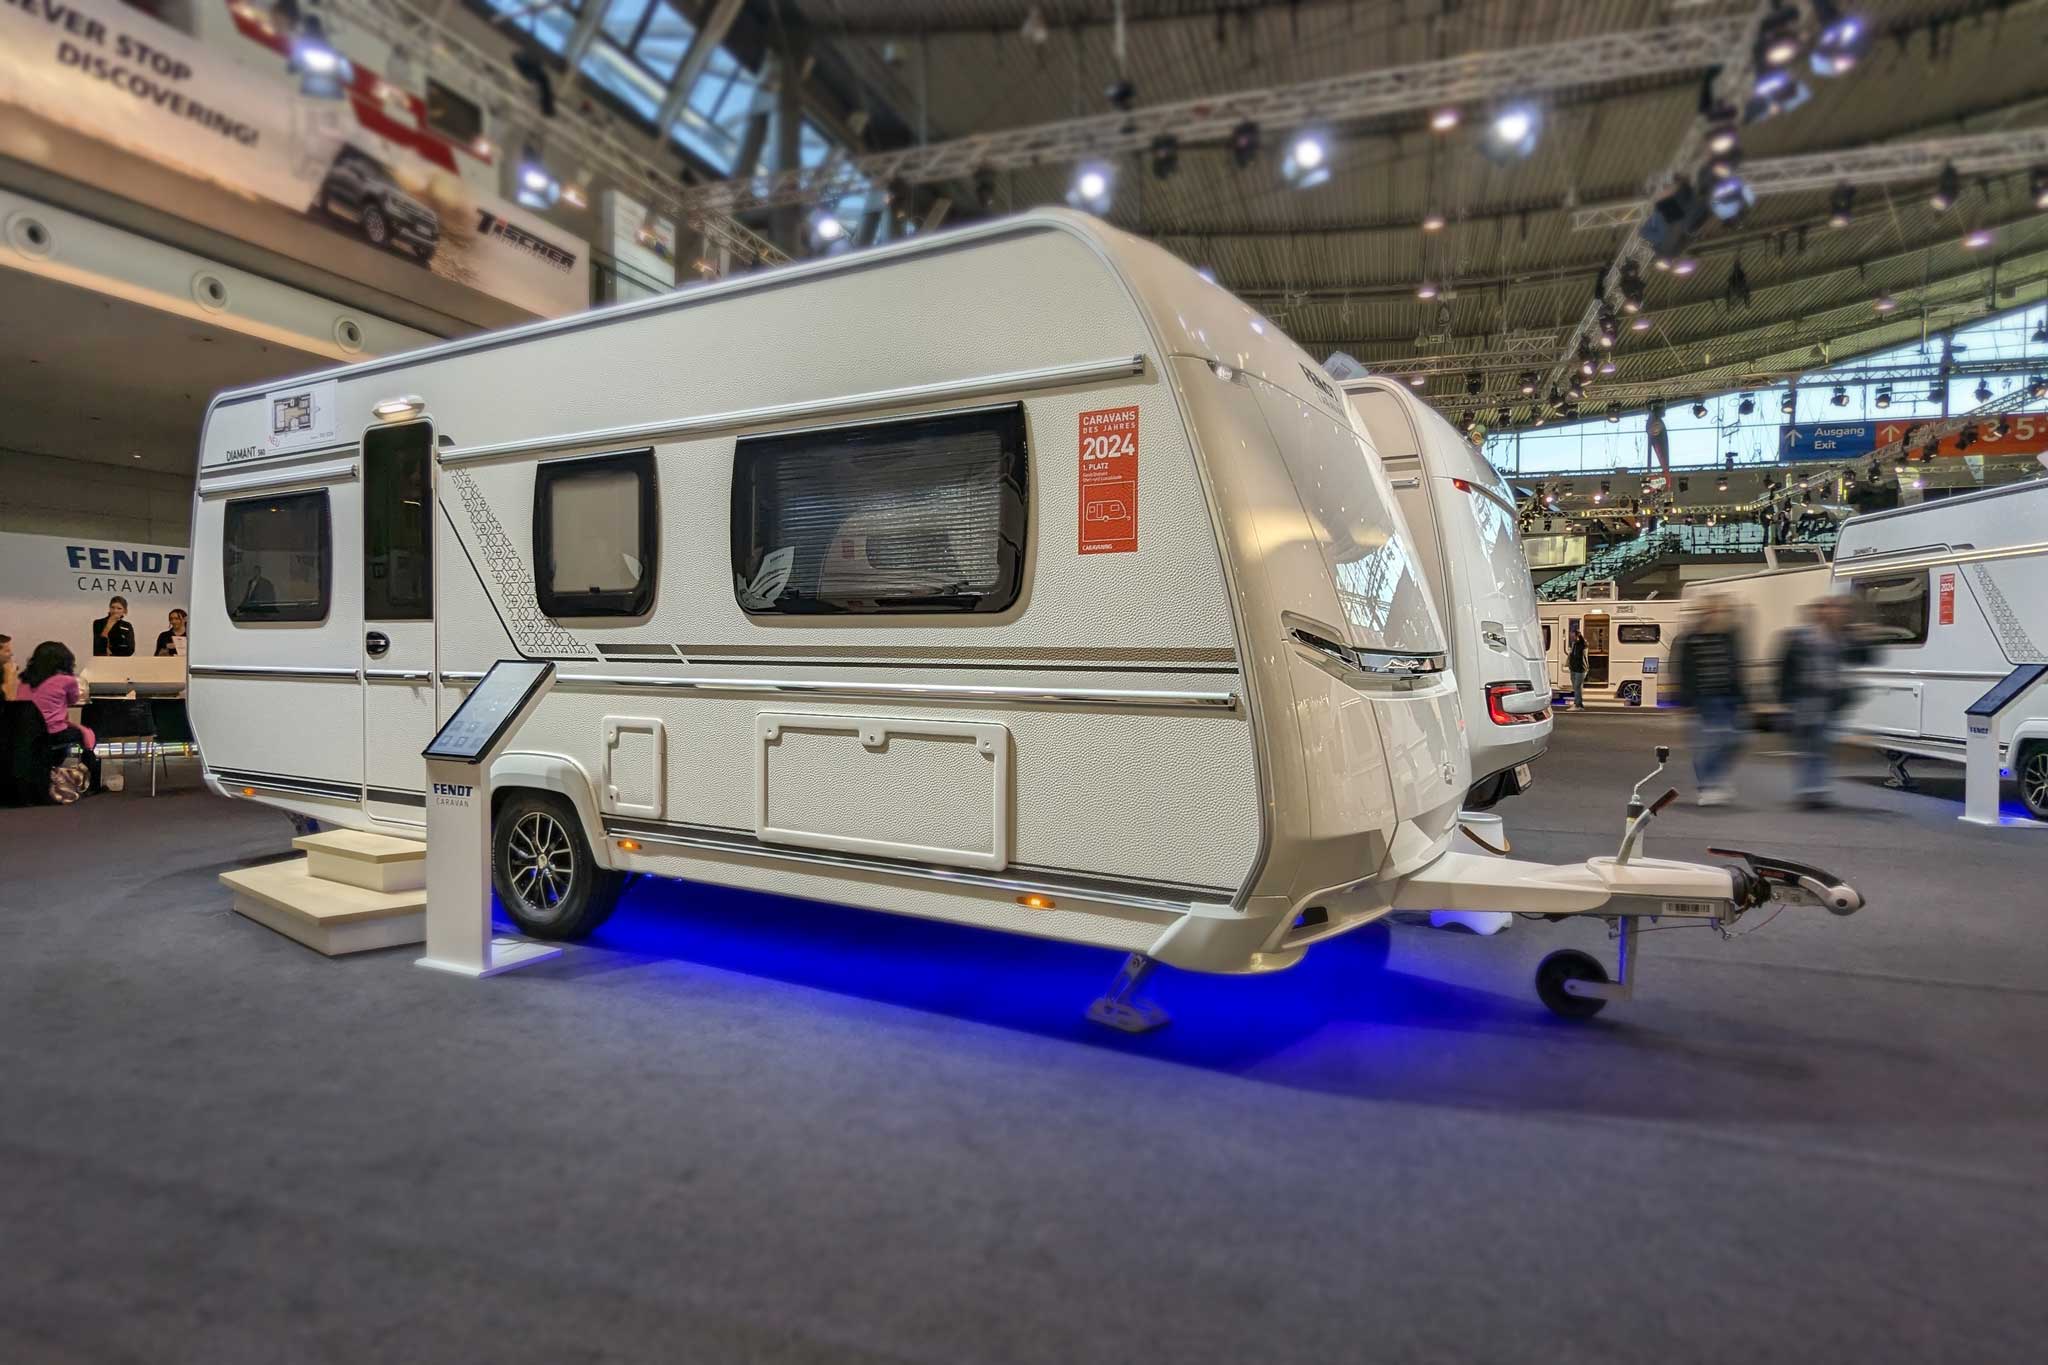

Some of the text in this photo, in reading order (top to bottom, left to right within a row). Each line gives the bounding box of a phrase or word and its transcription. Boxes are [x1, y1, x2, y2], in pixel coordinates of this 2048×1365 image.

[3, 0, 194, 82] EVER STOP
[56, 41, 260, 147] DISCOVERING!
[1083, 411, 1136, 426] CARAVANS
[1083, 421, 1136, 434] DES JAHRES
[1814, 427, 1865, 441] Ausgang
[1083, 433, 1135, 460] 2024
[1814, 440, 1836, 450] Exit
[226, 446, 256, 461] DIAMANT
[1088, 462, 1109, 471] PLATZ
[66, 546, 185, 575] FENDT
[77, 577, 173, 595] CARAVAN
[433, 784, 473, 797] FENDT
[436, 798, 469, 807] CARAVAN
